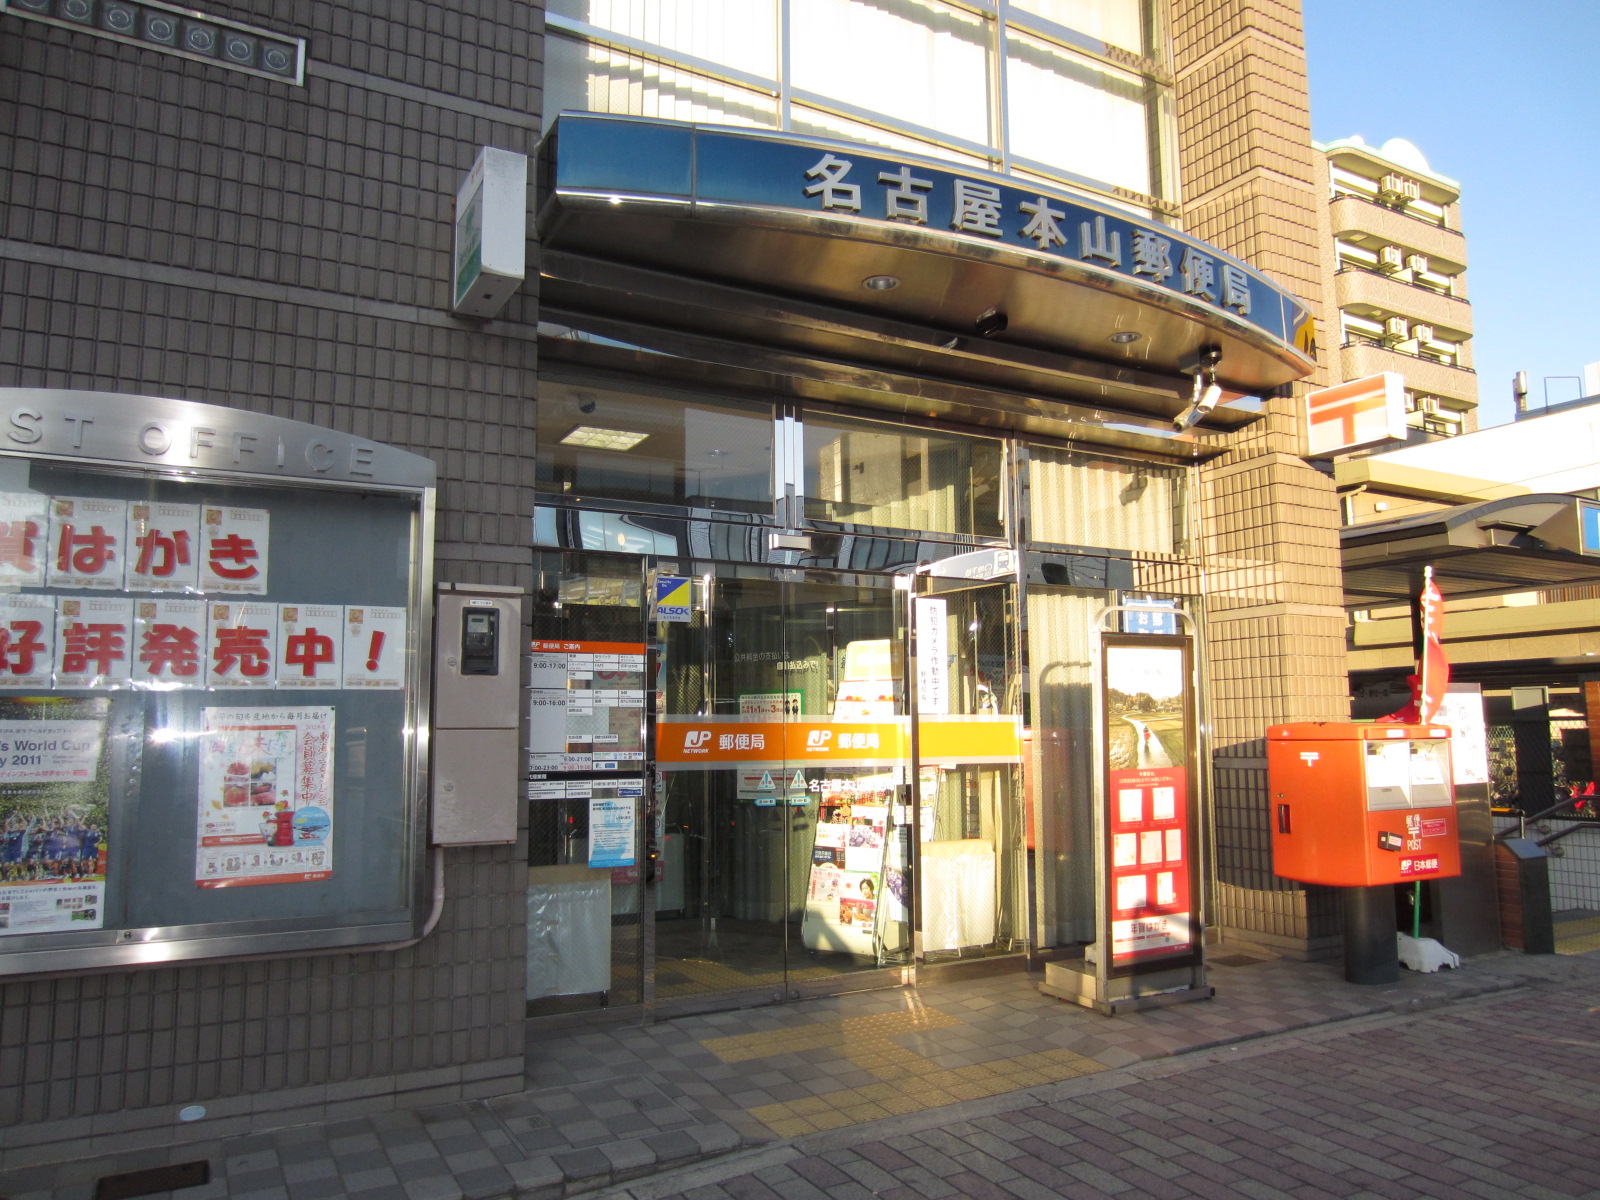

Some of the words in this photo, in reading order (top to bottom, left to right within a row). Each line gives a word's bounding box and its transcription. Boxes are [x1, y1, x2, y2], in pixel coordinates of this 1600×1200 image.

[805, 153, 1252, 315] 名古屋本山郵便局
[8, 407, 94, 449] ST
[137, 421, 375, 478] OFFICE
[657, 607, 689, 616] ALSOK
[533, 661, 566, 670] 9:00-17:00
[533, 698, 566, 707] 9:00-16:00
[15, 739, 57, 751] World
[61, 739, 91, 753] Cup
[719, 734, 765, 751] 郵便局
[837, 732, 880, 750] 郵便局
[12, 754, 42, 766] 2011
[301, 731, 315, 805] 会員募集中
[529, 763, 559, 771] 7:00-23:00
[563, 763, 592, 771] 9:00-19:00
[1405, 813, 1421, 827] 郵便
[1406, 839, 1422, 851] POST
[1414, 858, 1439, 871] 日本郵便
[1130, 919, 1168, 935] 年賀はがき
